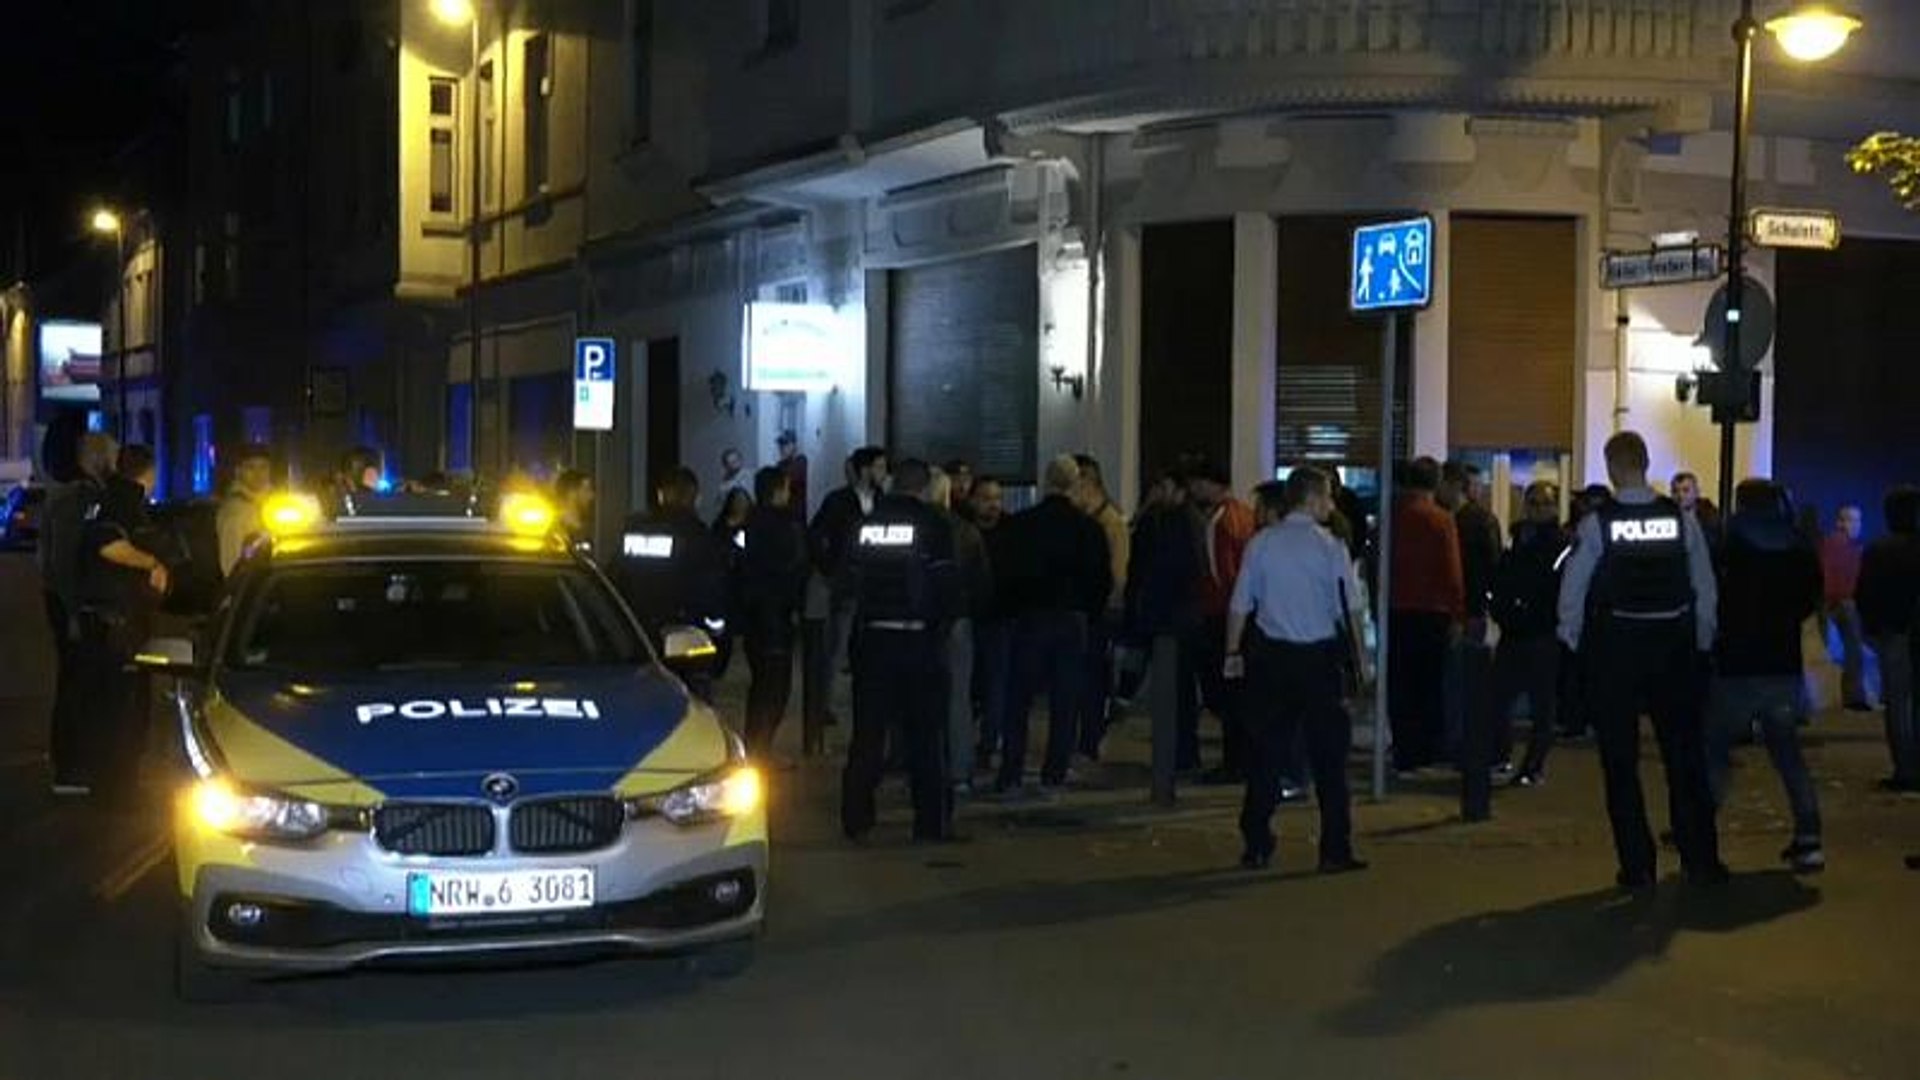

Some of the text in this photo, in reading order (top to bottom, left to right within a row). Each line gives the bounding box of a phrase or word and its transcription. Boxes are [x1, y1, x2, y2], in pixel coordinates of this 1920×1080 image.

[584, 344, 606, 381] P
[859, 525, 914, 546] POLIZEI
[1611, 518, 1679, 542] POLIZEI
[355, 697, 600, 724] POLIZEI
[528, 873, 592, 903] 3081
